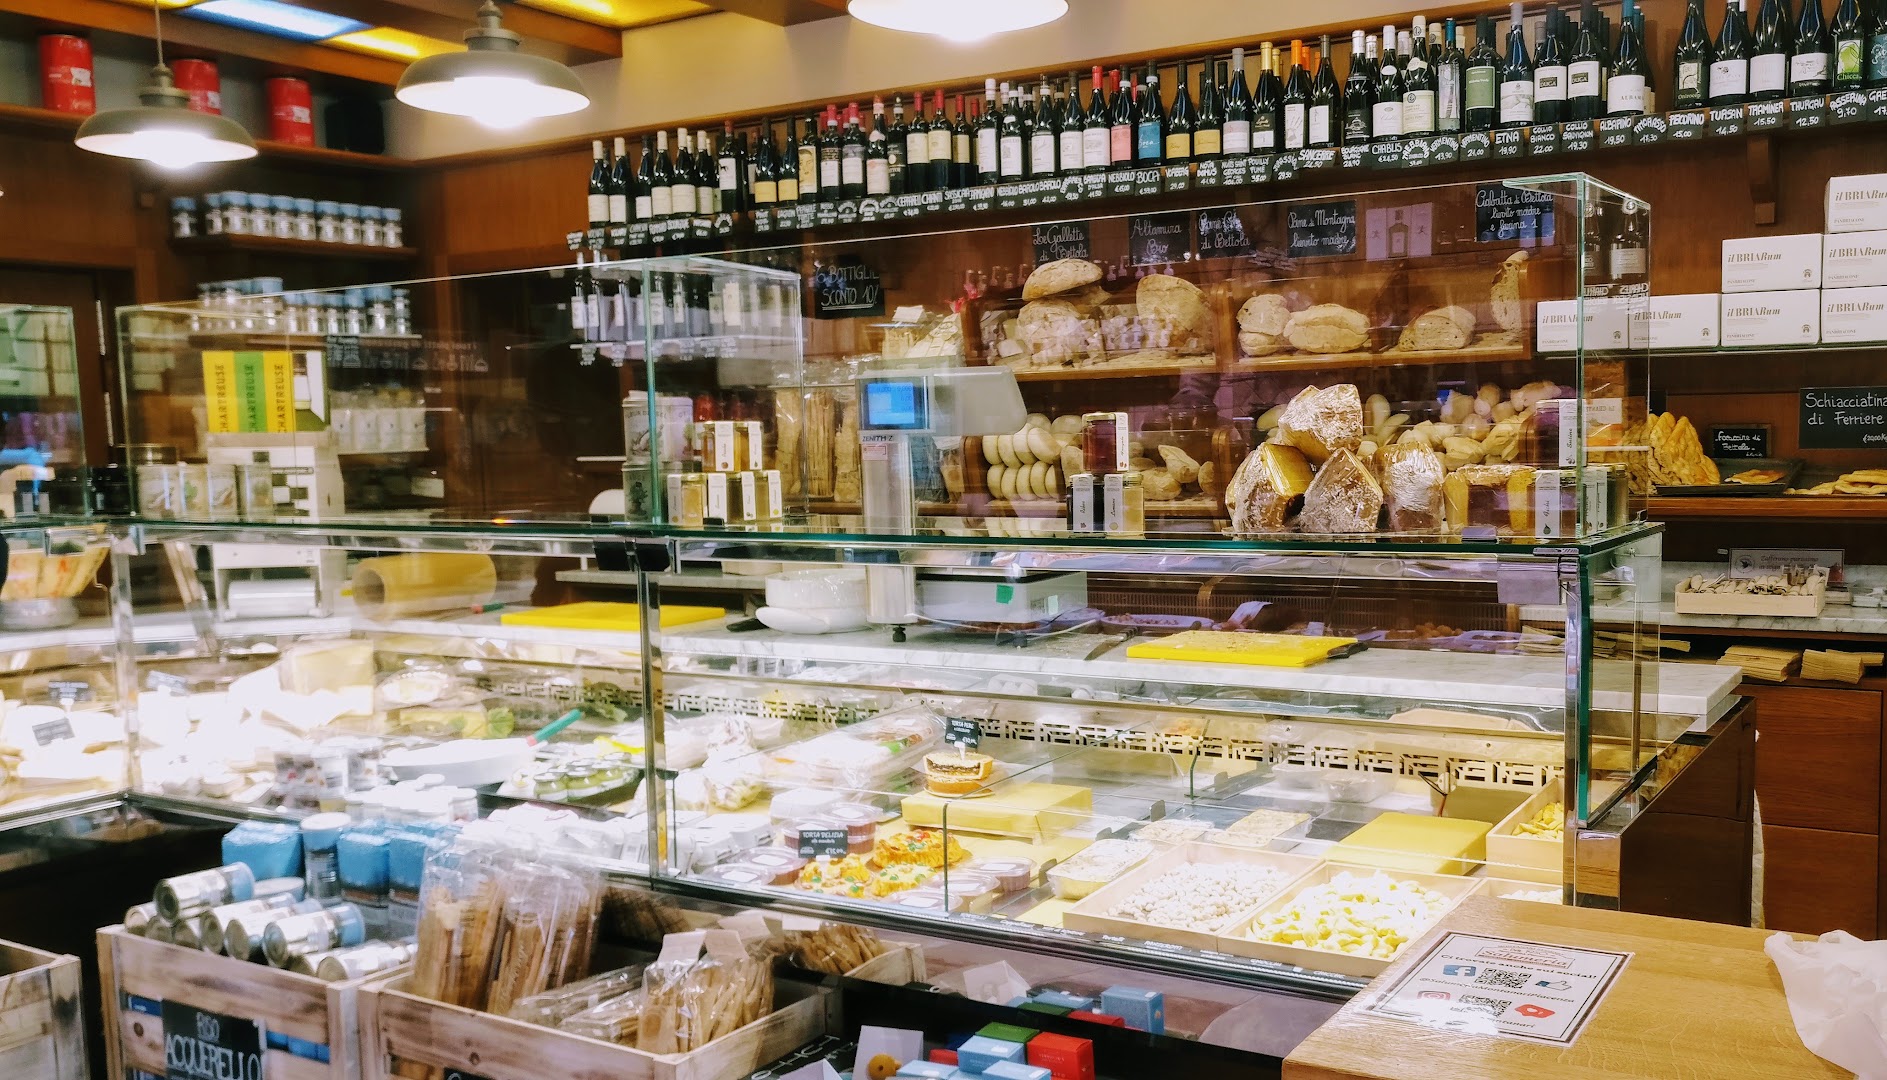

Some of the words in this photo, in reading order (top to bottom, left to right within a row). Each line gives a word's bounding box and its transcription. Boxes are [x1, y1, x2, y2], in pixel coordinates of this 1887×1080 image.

[1790, 97, 1824, 113] THURGAU
[1668, 113, 1704, 126] PECORINO
[1709, 108, 1744, 122] TURSAN
[1754, 116, 1776, 127] 15,50
[1796, 116, 1819, 127] 12,50
[1565, 123, 1589, 131] COLLIO
[1673, 130, 1693, 138] 15,00
[1495, 131, 1520, 145] ETNA
[1530, 134, 1556, 144] BIANCO
[1604, 134, 1625, 145] 19,50
[1298, 149, 1336, 161] SANCERRE
[1372, 143, 1403, 155] CHABLIS
[1108, 171, 1135, 184] NEBBIOLO
[1135, 170, 1160, 185] BOCA
[1475, 190, 1512, 208] Ciabatta
[1314, 209, 1356, 232] Montagna
[1130, 218, 1183, 240] Altamura
[1146, 238, 1169, 256] Bio
[1214, 232, 1251, 249] Bettola
[820, 287, 857, 307] SCONTO
[1805, 392, 1887, 408] Schiacciatina
[1807, 412, 1825, 425] di
[1833, 411, 1885, 425] Ferriere
[1482, 949, 1568, 967] Salumeria
[1456, 955, 1496, 966] trovate
[1499, 960, 1534, 971] anche
[1537, 966, 1555, 974] sui
[1557, 969, 1597, 980] social!
